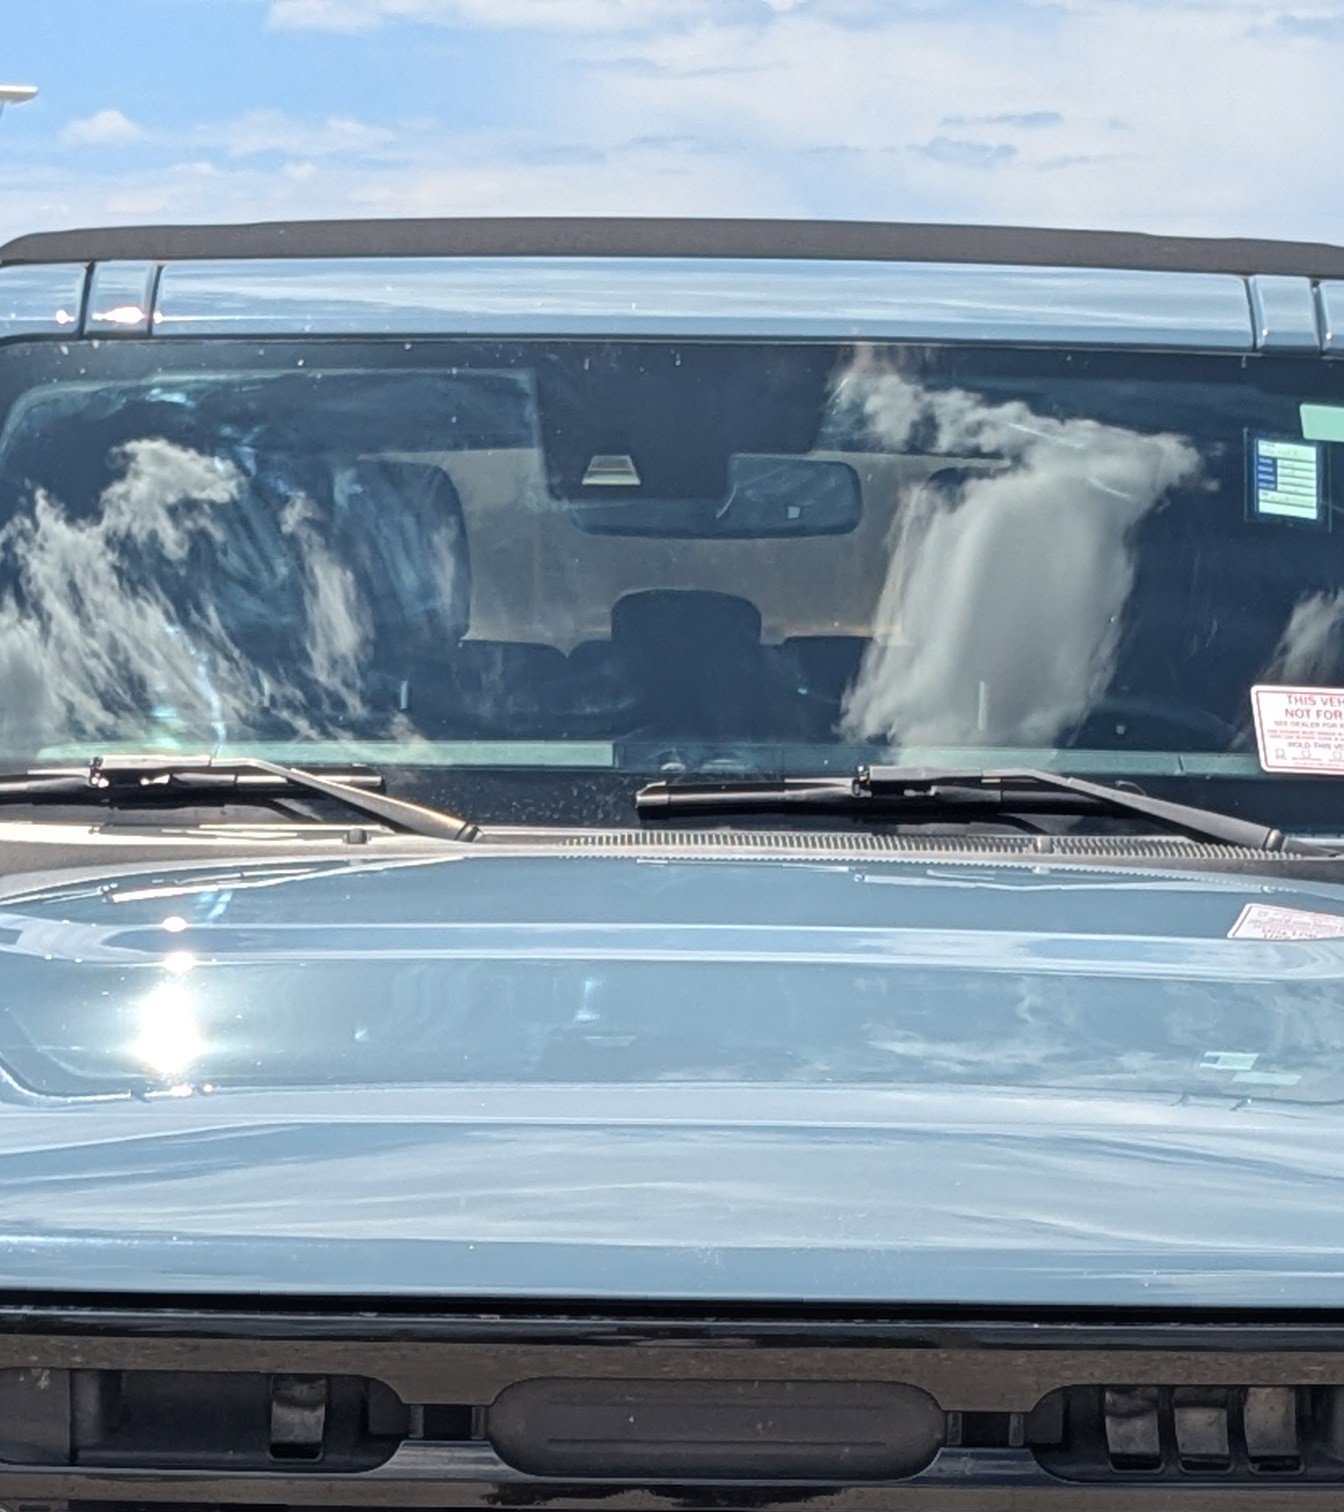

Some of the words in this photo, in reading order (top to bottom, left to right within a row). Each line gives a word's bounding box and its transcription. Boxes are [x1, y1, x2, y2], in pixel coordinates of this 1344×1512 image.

[1287, 693, 1317, 706] THIS
[1285, 708, 1311, 719] NOT
[1316, 709, 1343, 721] FOR
